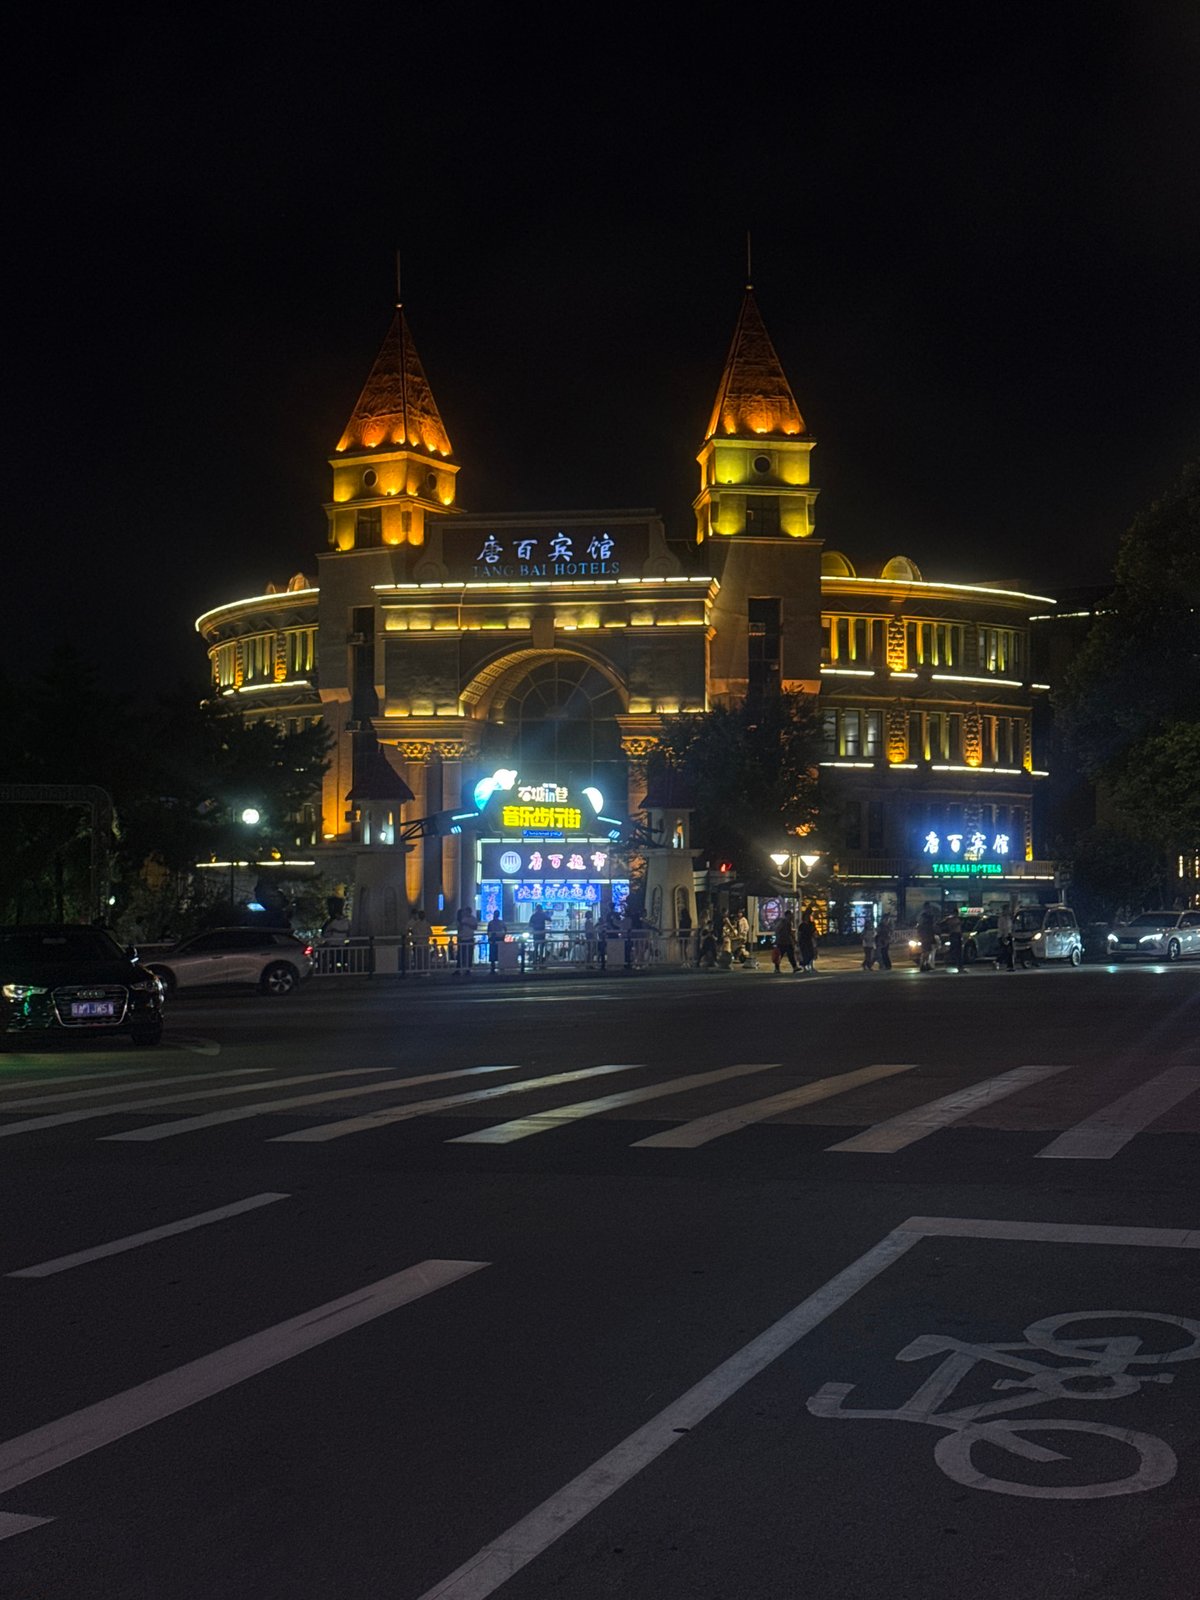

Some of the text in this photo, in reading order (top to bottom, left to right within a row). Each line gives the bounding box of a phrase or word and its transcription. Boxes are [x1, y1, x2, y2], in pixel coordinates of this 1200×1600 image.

[477, 532, 615, 563] 唐百宾馆
[472, 562, 620, 577] TANG BAI HOTELS
[502, 806, 581, 828] 音乐步行街
[923, 831, 1009, 855] 唐百宾馆
[528, 851, 608, 872] 唐百超市
